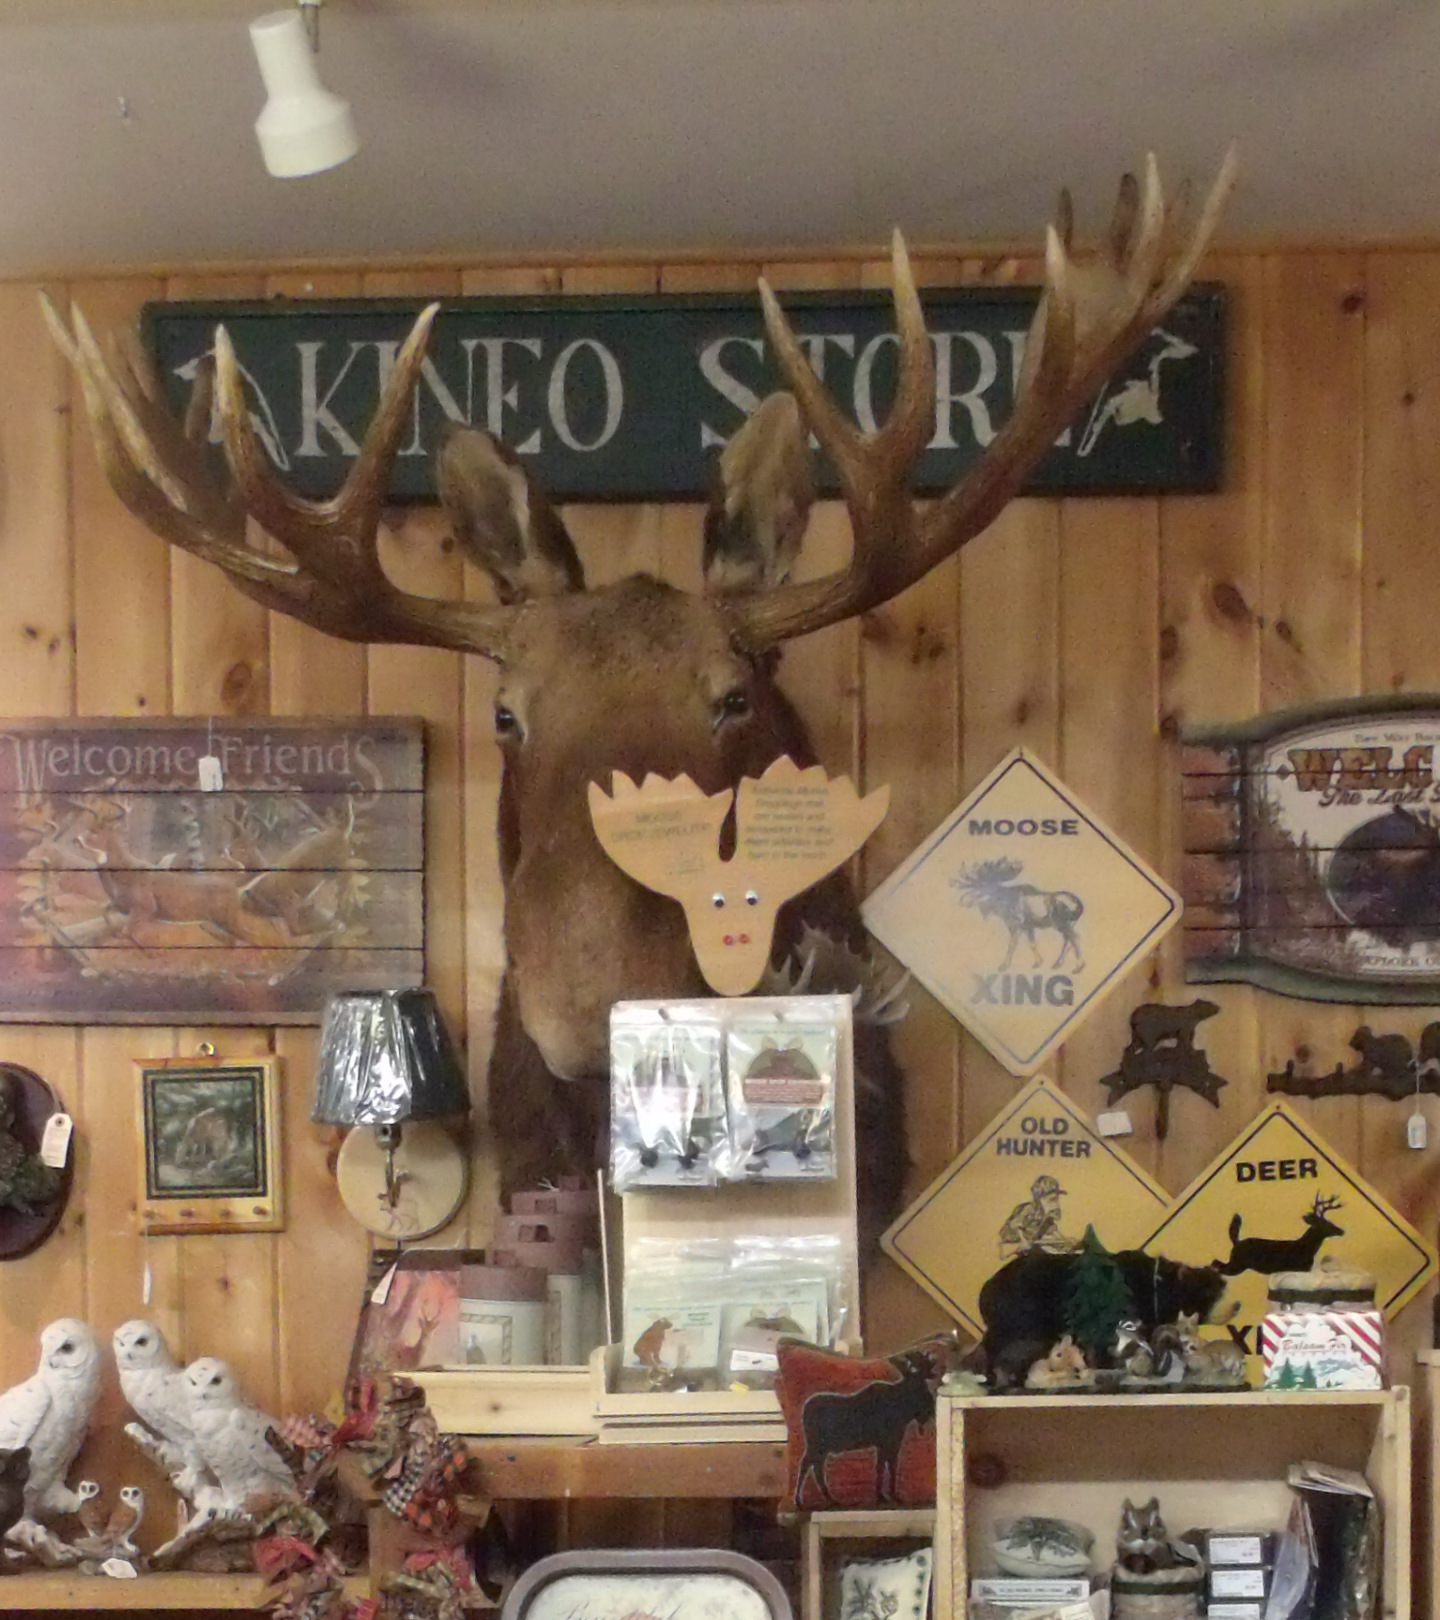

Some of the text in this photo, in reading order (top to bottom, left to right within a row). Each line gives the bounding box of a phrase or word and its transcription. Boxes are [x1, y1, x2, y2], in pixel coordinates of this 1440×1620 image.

[698, 329, 1072, 450] STOR
[967, 817, 1080, 837] MOOSE
[970, 972, 1075, 1007] XING
[1019, 1115, 1070, 1137] OLD
[995, 1136, 1093, 1160] HUNTER
[1235, 1158, 1319, 1183] DEER
[1225, 1323, 1263, 1356] XI
